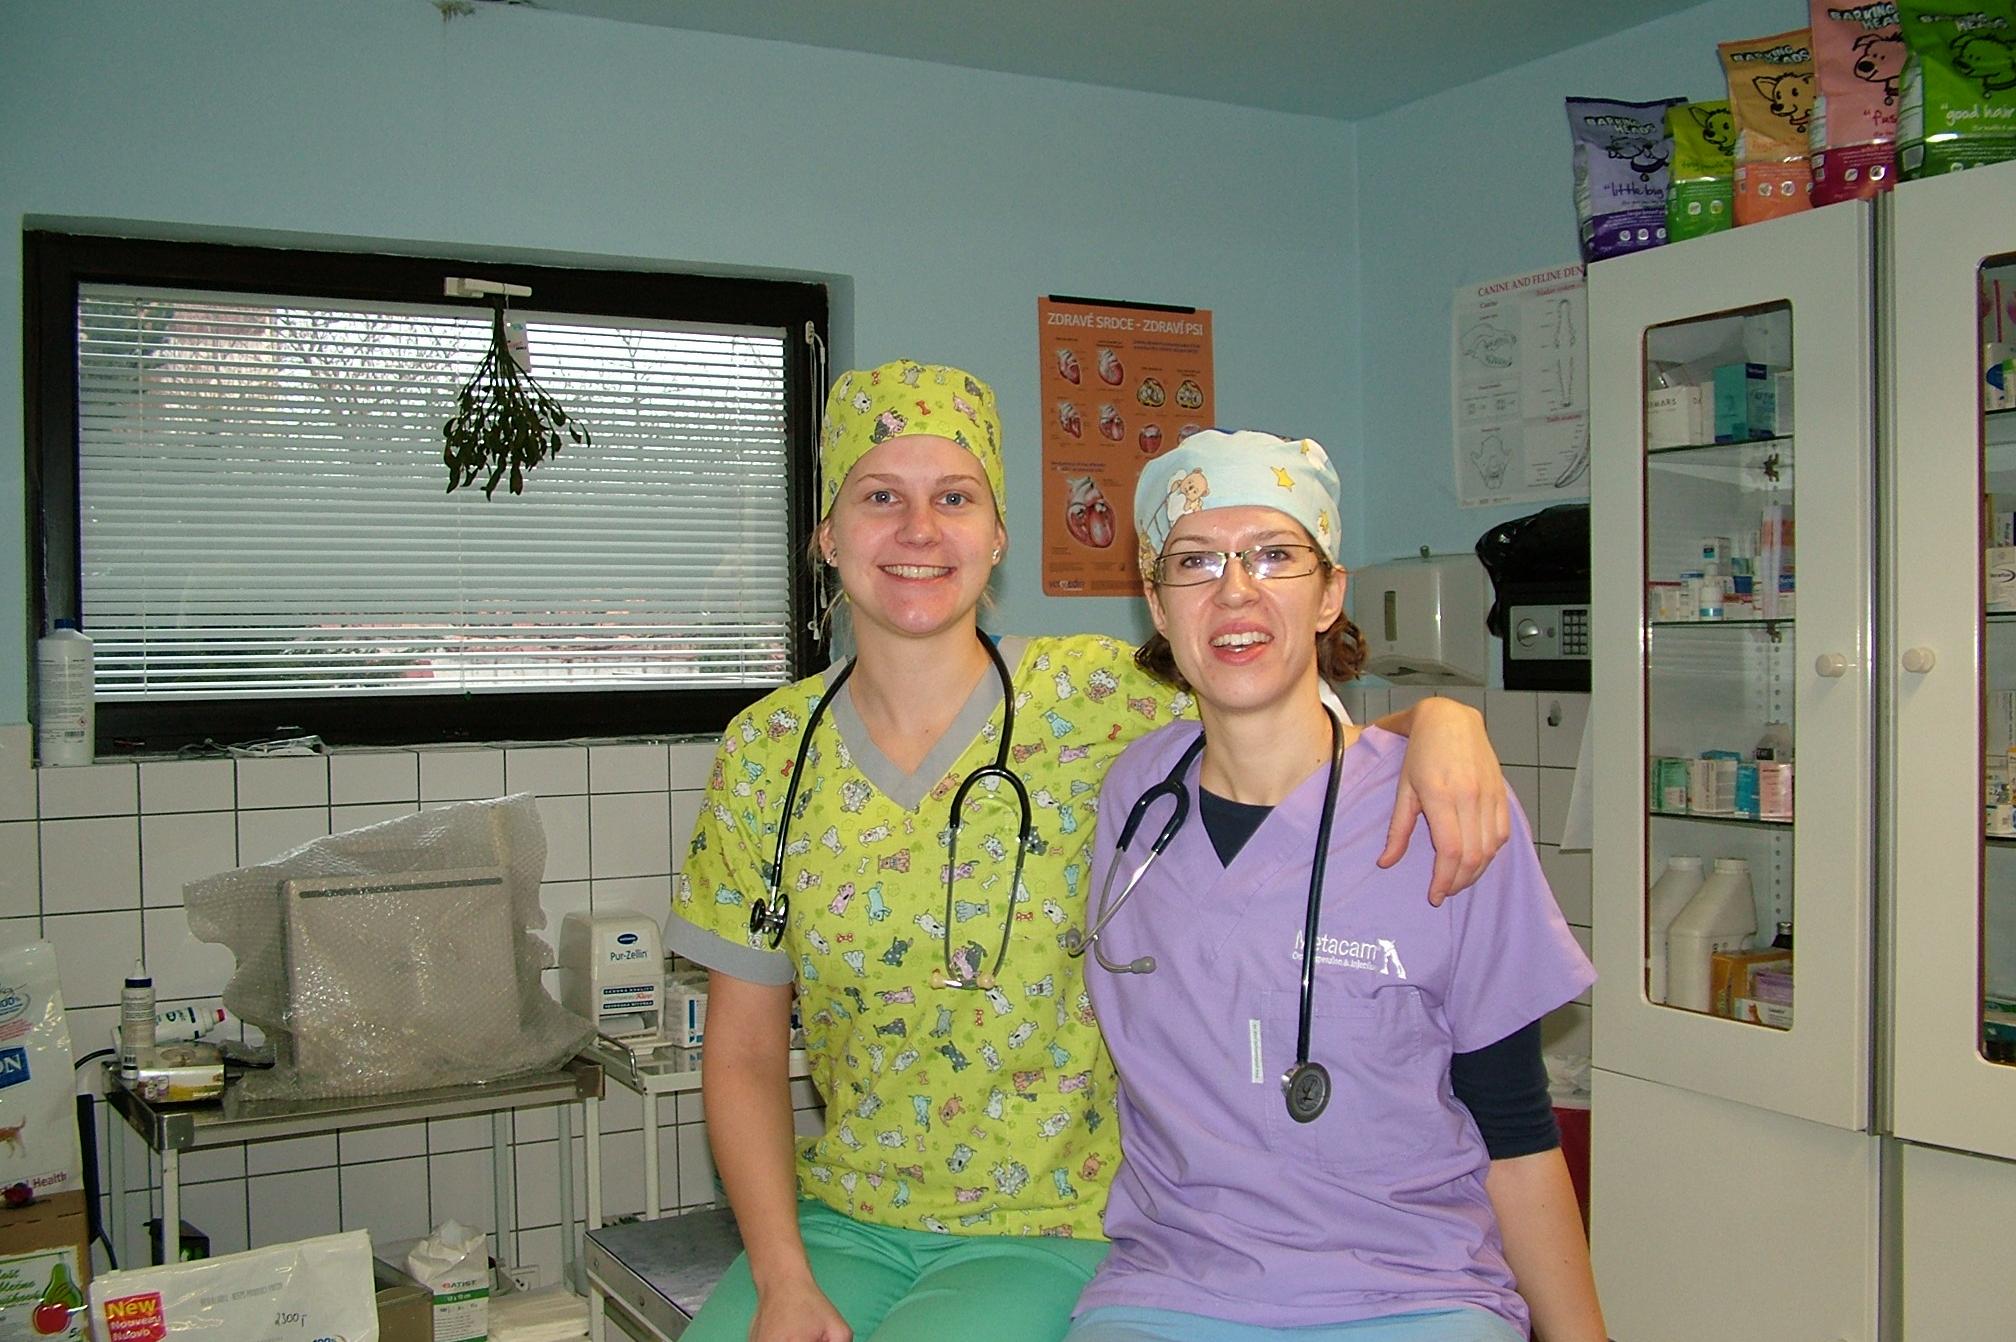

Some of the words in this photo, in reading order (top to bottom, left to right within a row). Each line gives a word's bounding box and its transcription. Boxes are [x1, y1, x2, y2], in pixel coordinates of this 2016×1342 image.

[1862, 13, 1900, 31] HEA
[1478, 281, 1512, 297] CANINE
[1511, 276, 1532, 290] AND
[1531, 269, 1562, 286] FELINE
[1563, 263, 1585, 278] DEN
[1047, 312, 1095, 328] ZDRAVÉ
[1096, 315, 1135, 331] SRDCE
[1142, 319, 1185, 335] ZDRAVÍ
[1185, 321, 1204, 337] PSI
[33, 1171, 68, 1188] Health
[107, 1299, 157, 1319] New
